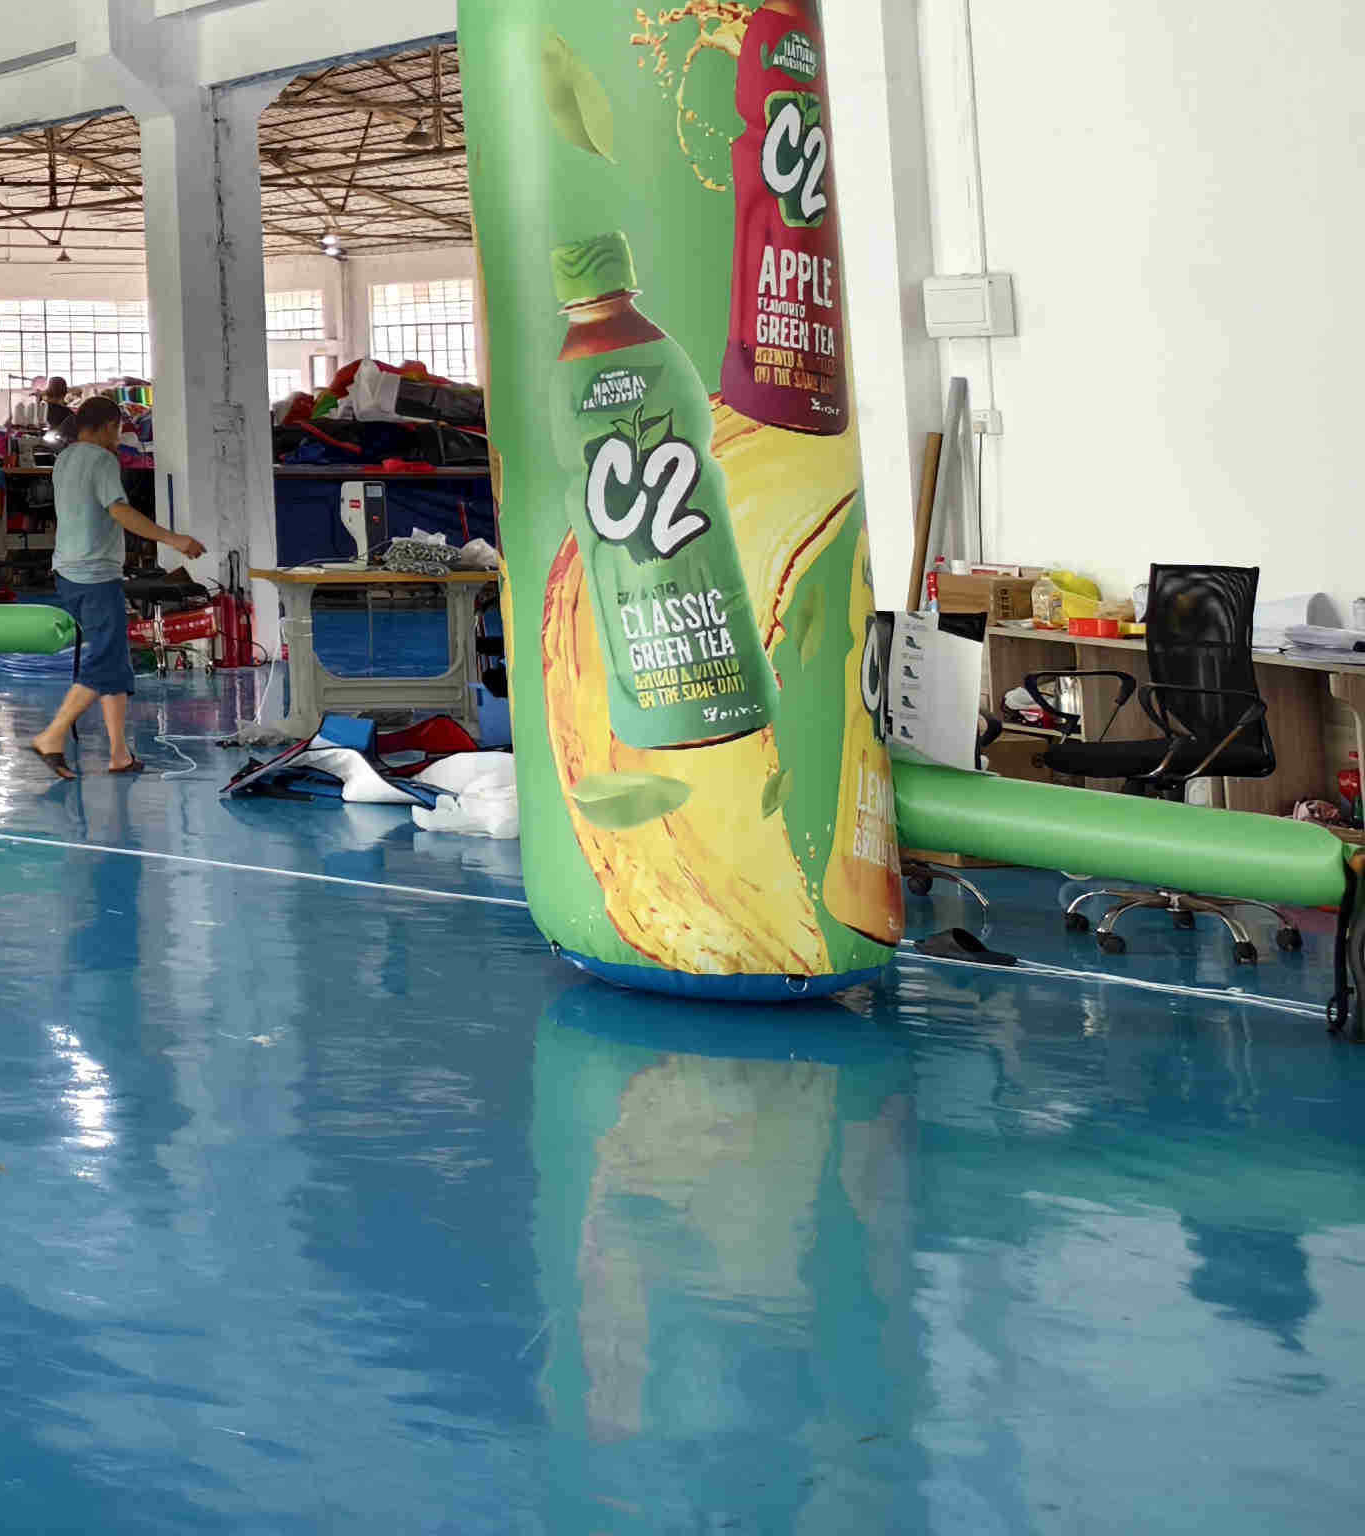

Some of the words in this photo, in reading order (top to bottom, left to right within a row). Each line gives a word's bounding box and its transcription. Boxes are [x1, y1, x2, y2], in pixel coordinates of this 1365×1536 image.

[762, 102, 827, 218] C2
[758, 244, 834, 309] APPLE
[756, 313, 810, 352] GREEN
[812, 323, 837, 358] TEA
[587, 438, 705, 554] C2
[621, 588, 727, 640] CLASSIC
[629, 634, 694, 673] GREEN
[695, 627, 737, 660] TEA
